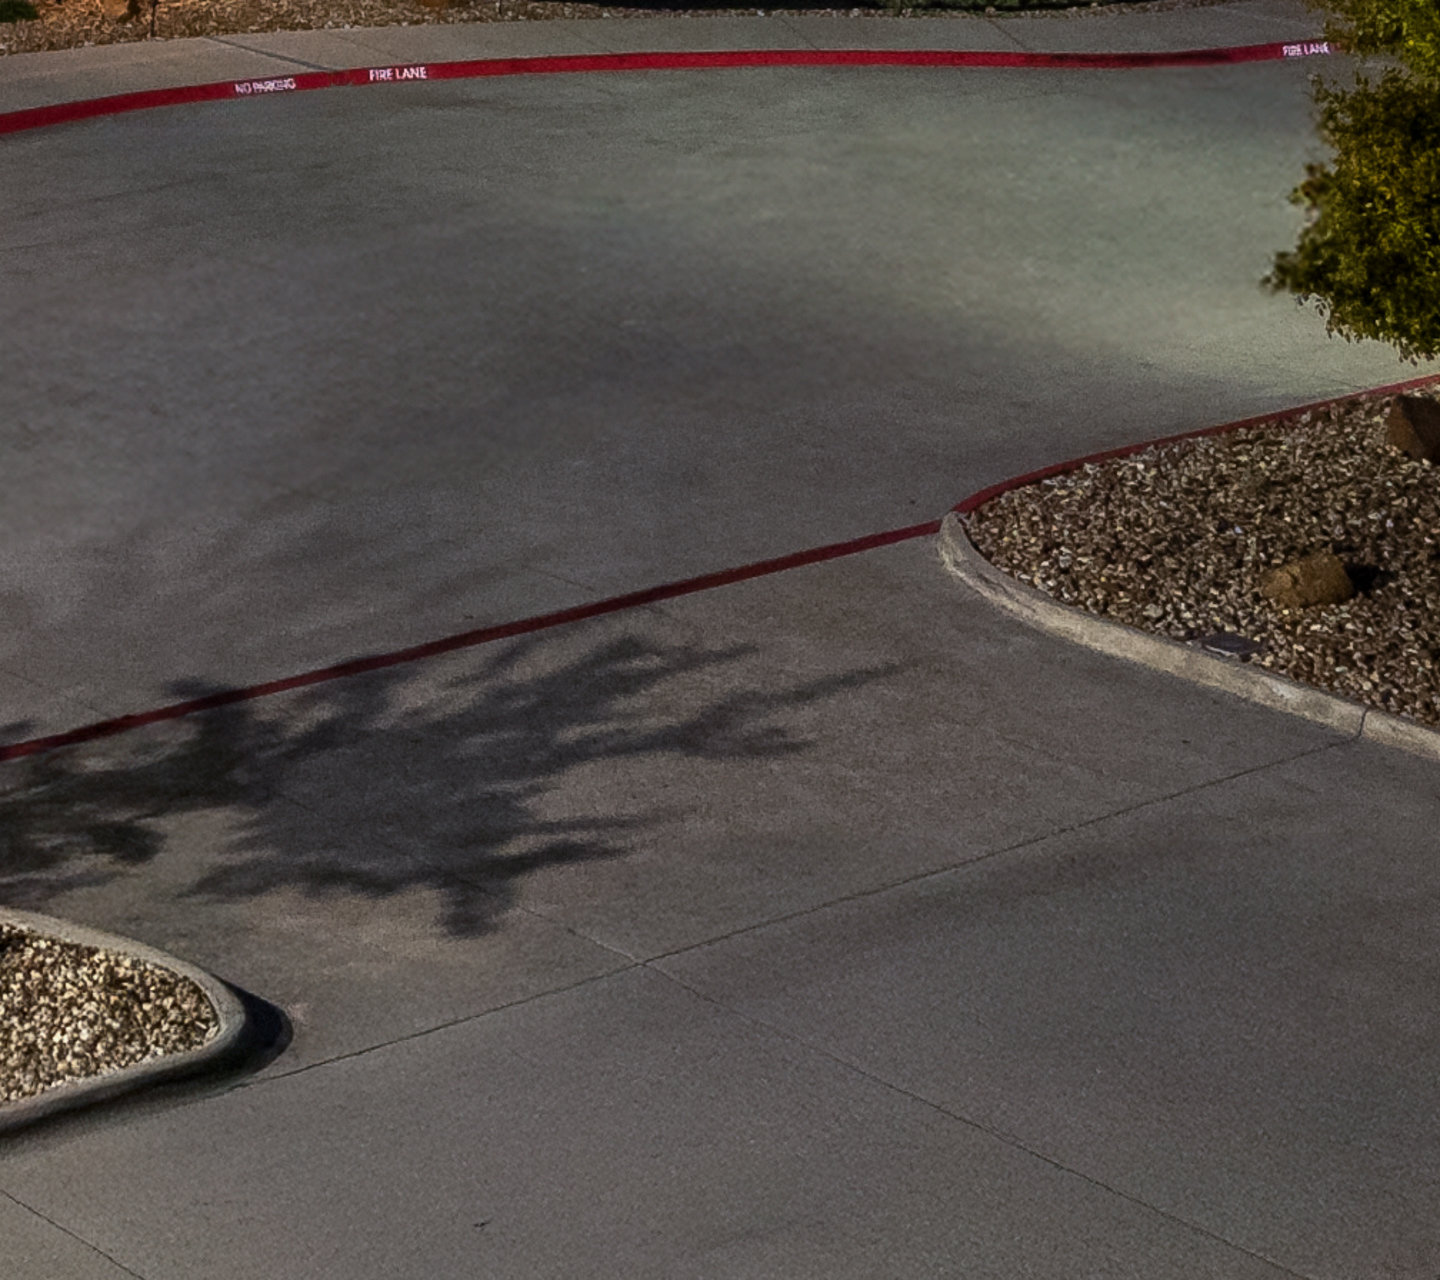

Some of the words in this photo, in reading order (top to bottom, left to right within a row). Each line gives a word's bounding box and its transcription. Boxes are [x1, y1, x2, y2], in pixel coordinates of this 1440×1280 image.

[369, 68, 393, 81] FIRE
[394, 66, 427, 80] LANE
[235, 82, 252, 94] NO
